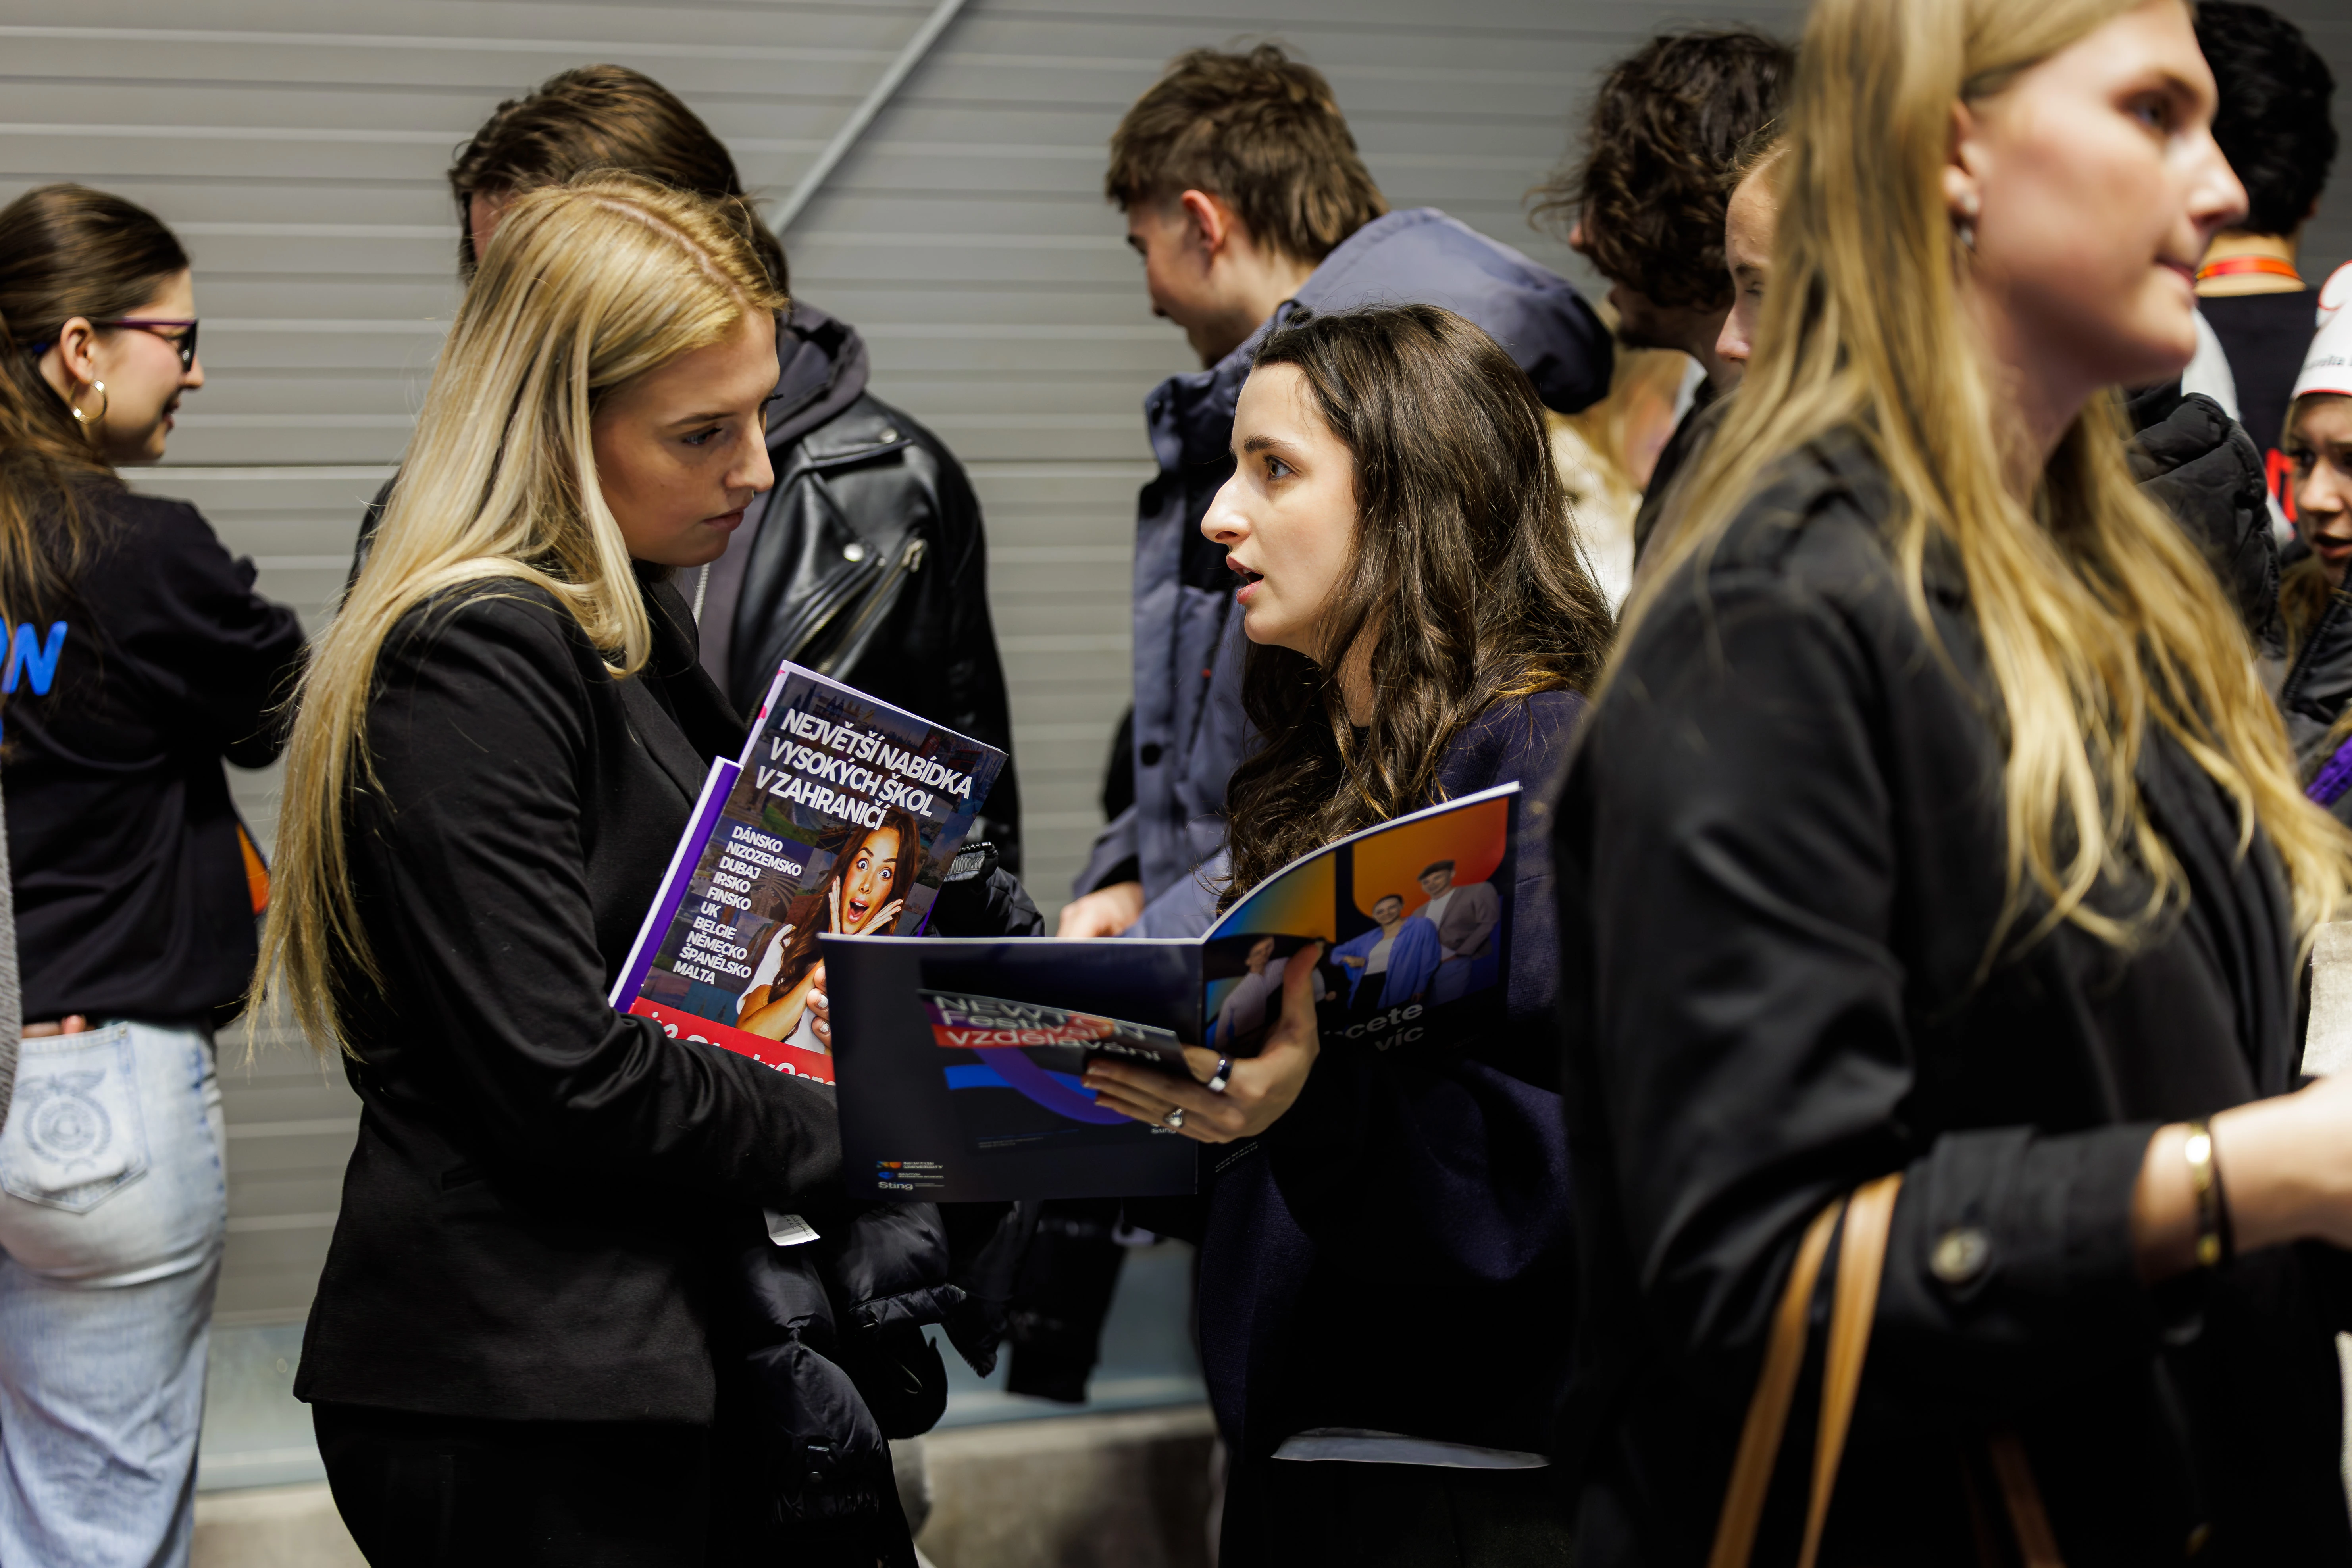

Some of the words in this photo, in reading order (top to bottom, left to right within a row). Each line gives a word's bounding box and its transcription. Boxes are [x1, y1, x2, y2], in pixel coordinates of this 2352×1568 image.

[781, 708, 886, 762] NEJVĚTŠÍ
[876, 743, 972, 799] NABÍDKA
[770, 737, 882, 796] VYSOKÝCH
[878, 773, 934, 818] ŠKOL
[756, 766, 776, 789] V
[769, 771, 891, 831] ZAHRANIČÍ
[731, 825, 783, 853] DÁNSKO
[719, 856, 762, 880] DUBAJ
[725, 841, 802, 876] NIZOZEMSKO
[712, 871, 751, 893] IRSKO
[700, 901, 722, 918] UK
[706, 886, 752, 910] FINSKO
[693, 916, 737, 940] BELGIE
[686, 931, 748, 960] NĚMECKO
[672, 960, 716, 985] MALTA
[679, 943, 751, 978] ŠPANĚLSKO
[1374, 1026, 1424, 1052] víc
[878, 1181, 914, 1191] Sting
